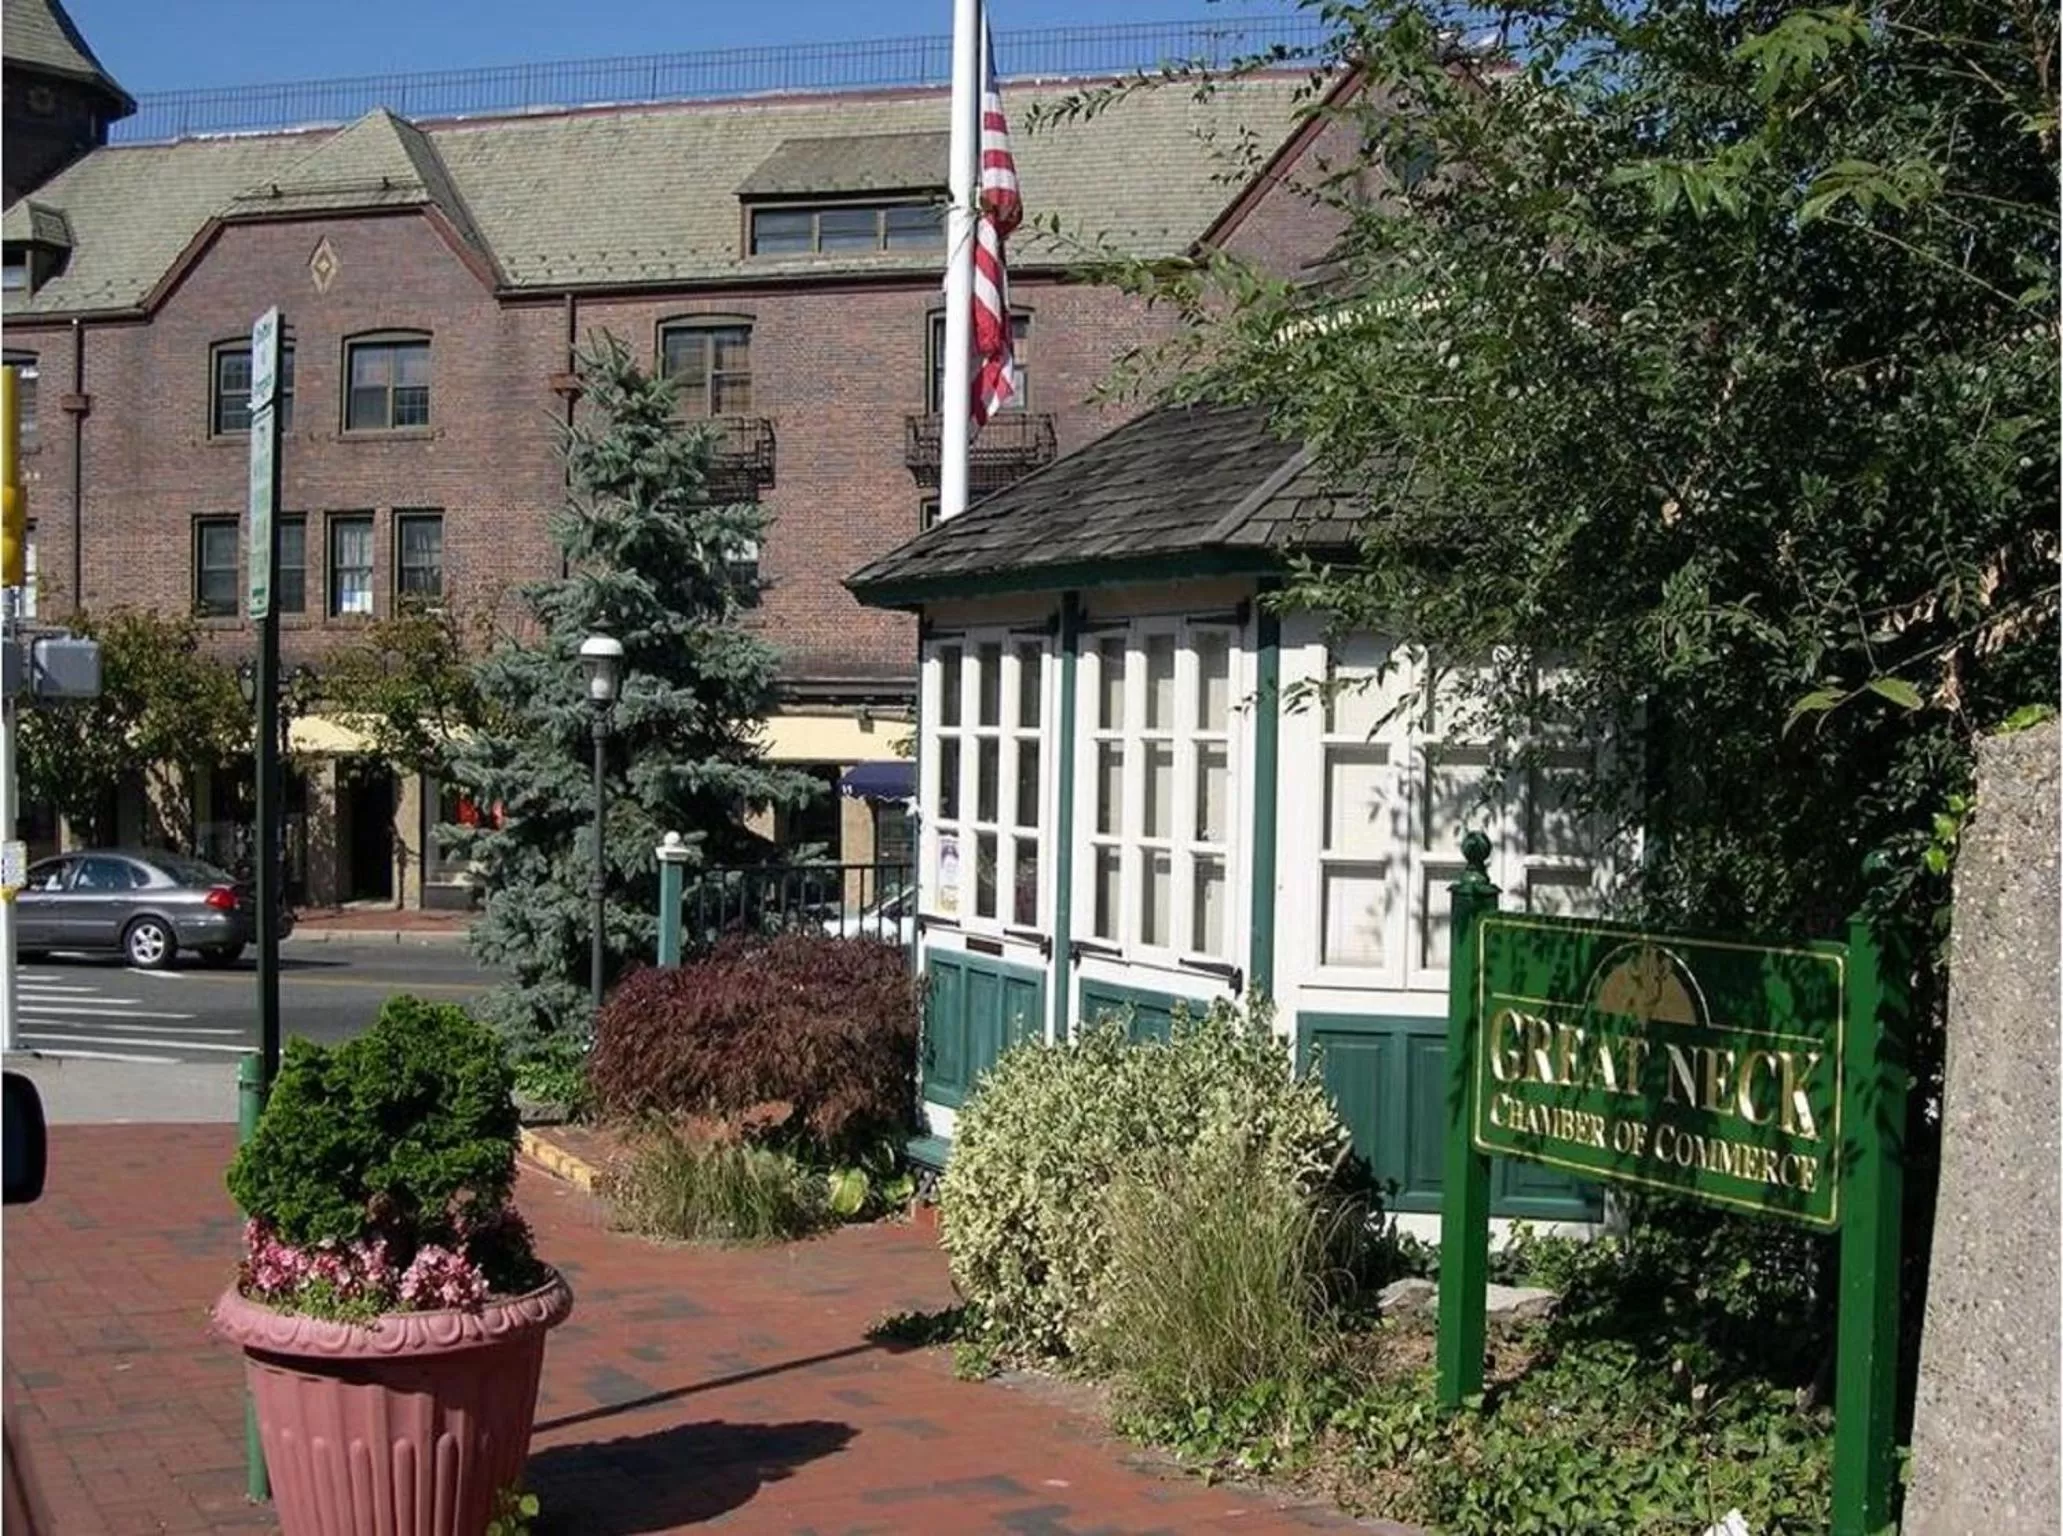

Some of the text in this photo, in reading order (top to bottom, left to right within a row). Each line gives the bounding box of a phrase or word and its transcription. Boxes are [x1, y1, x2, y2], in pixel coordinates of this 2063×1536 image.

[1490, 1007, 1823, 1142] GREAT NECK
[1489, 1092, 1818, 1193] CHAMBER OF COMMERCE
